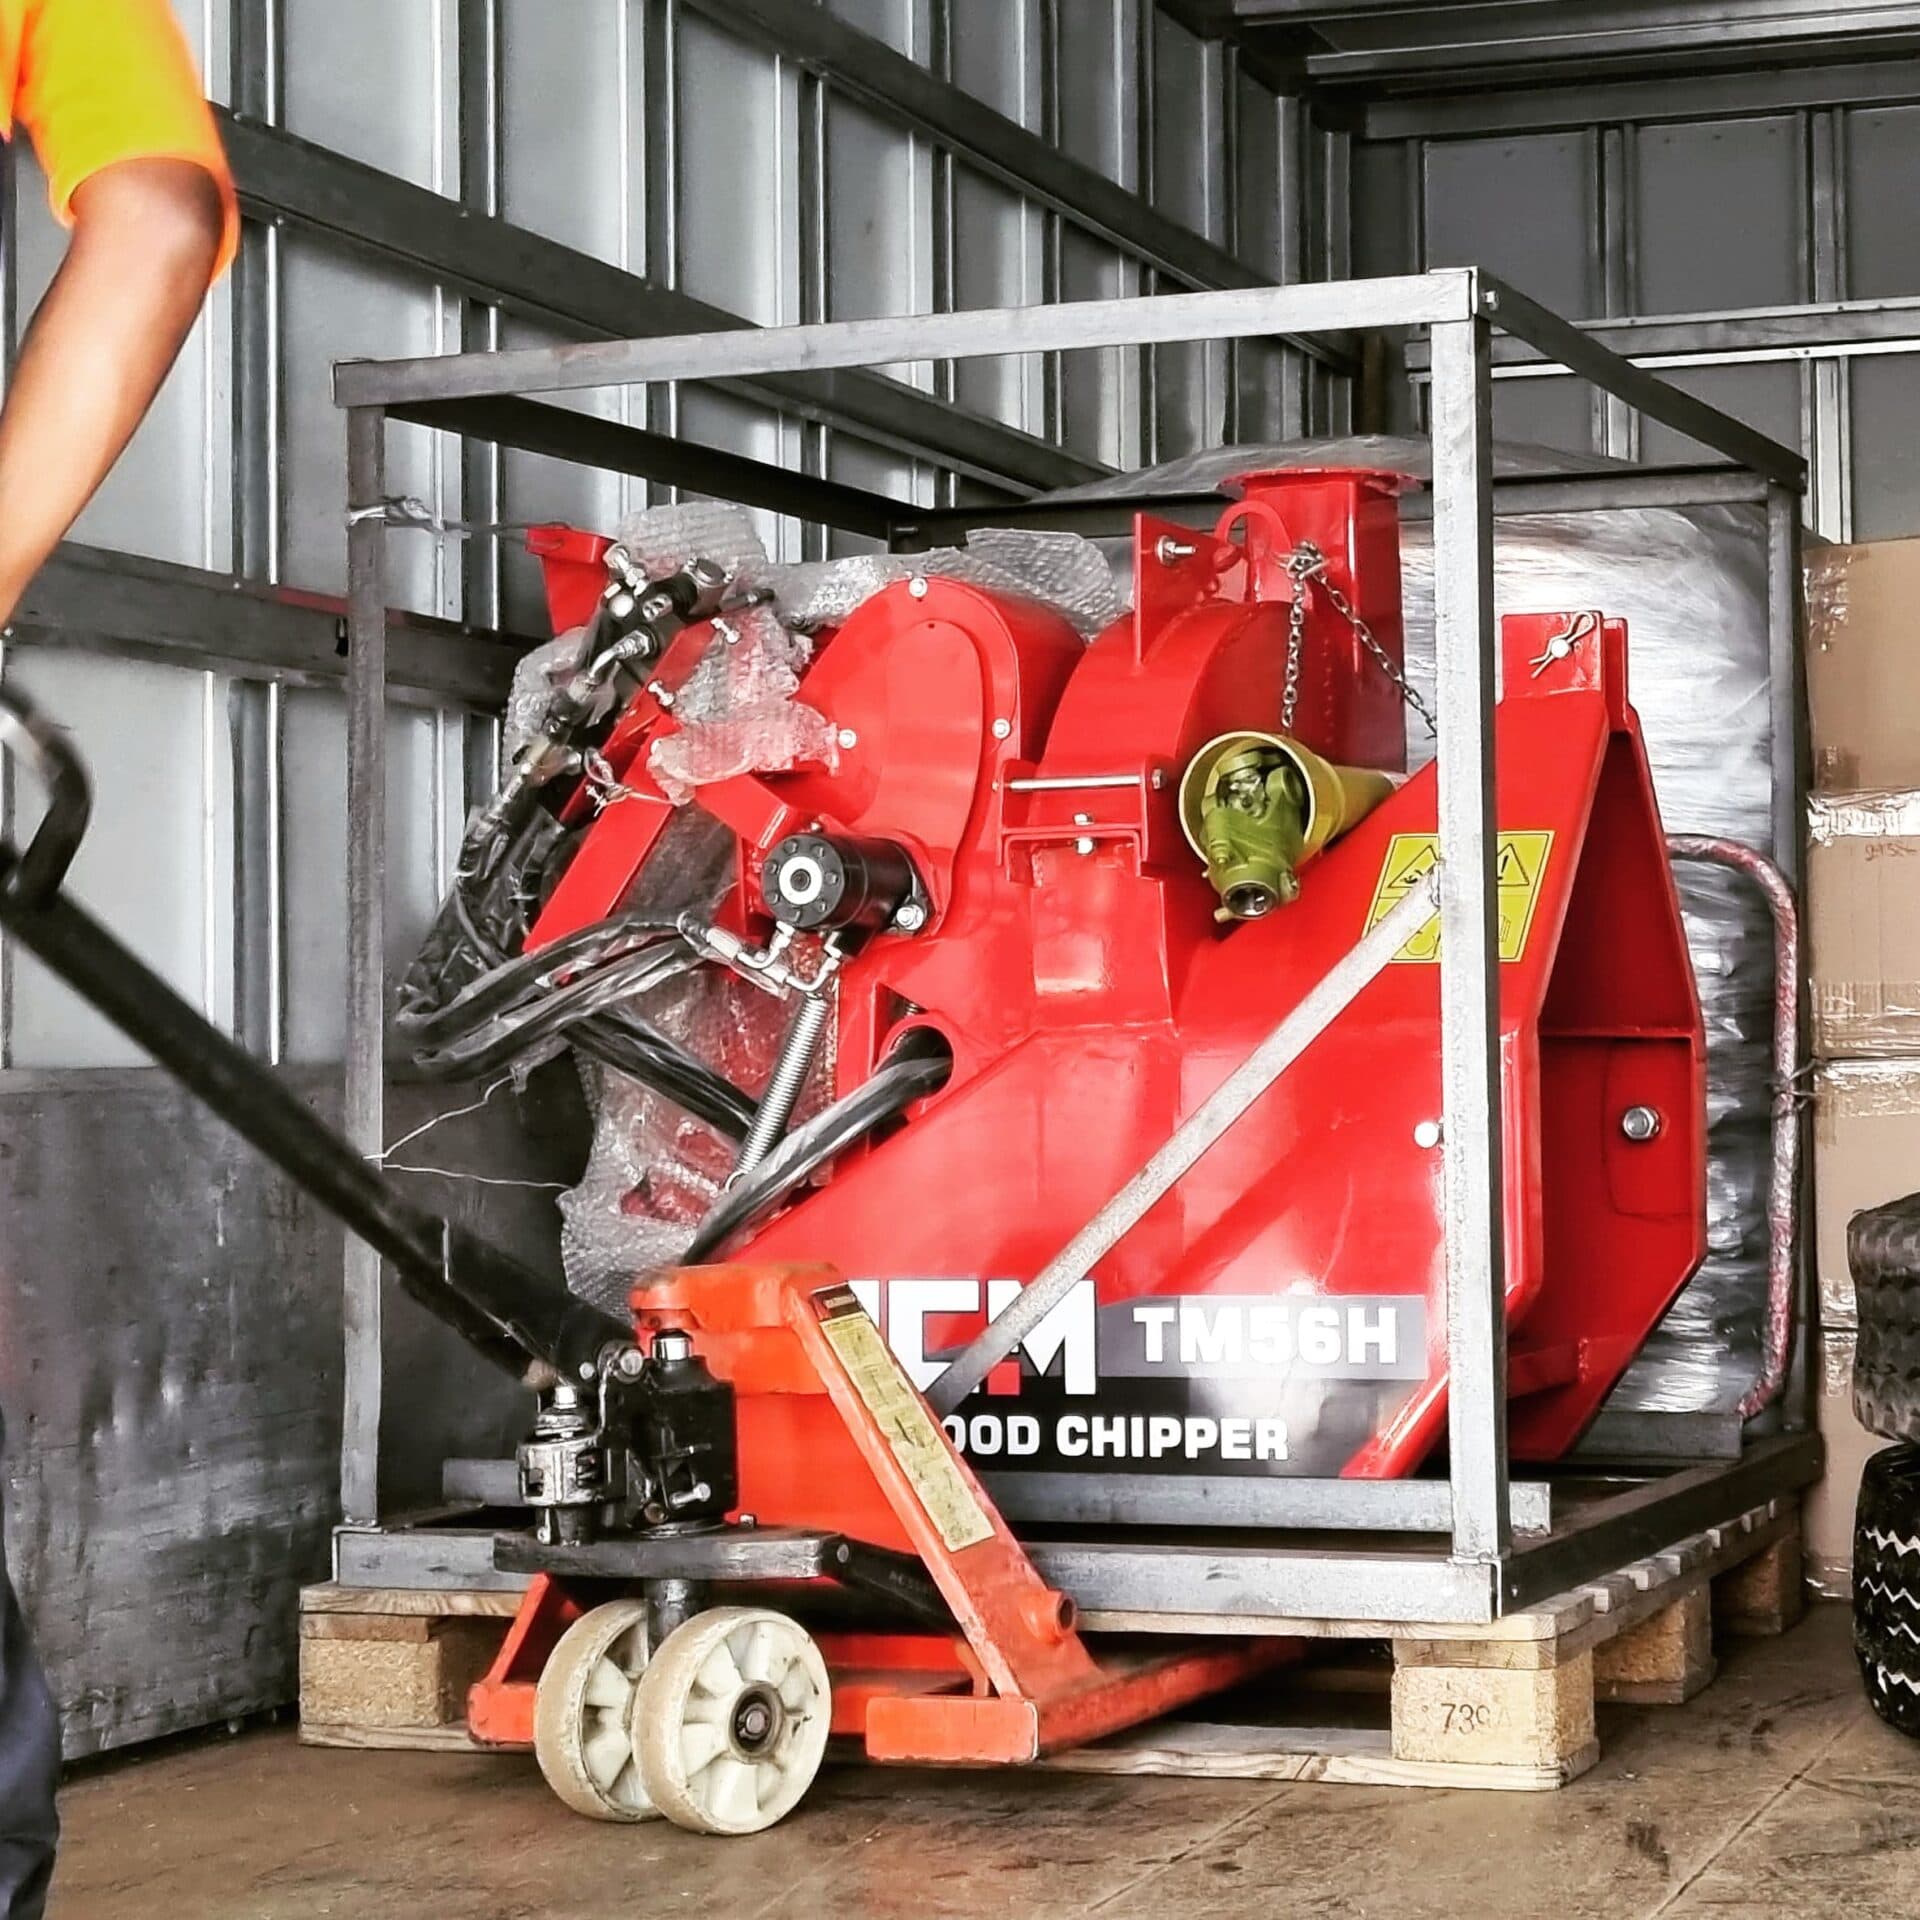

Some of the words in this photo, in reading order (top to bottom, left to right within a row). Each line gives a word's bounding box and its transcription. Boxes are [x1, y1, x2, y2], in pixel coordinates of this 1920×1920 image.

[1133, 1306, 1397, 1364] TM56H
[941, 1414, 1041, 1456] OOD
[1056, 1415, 1289, 1460] CHIPPER
